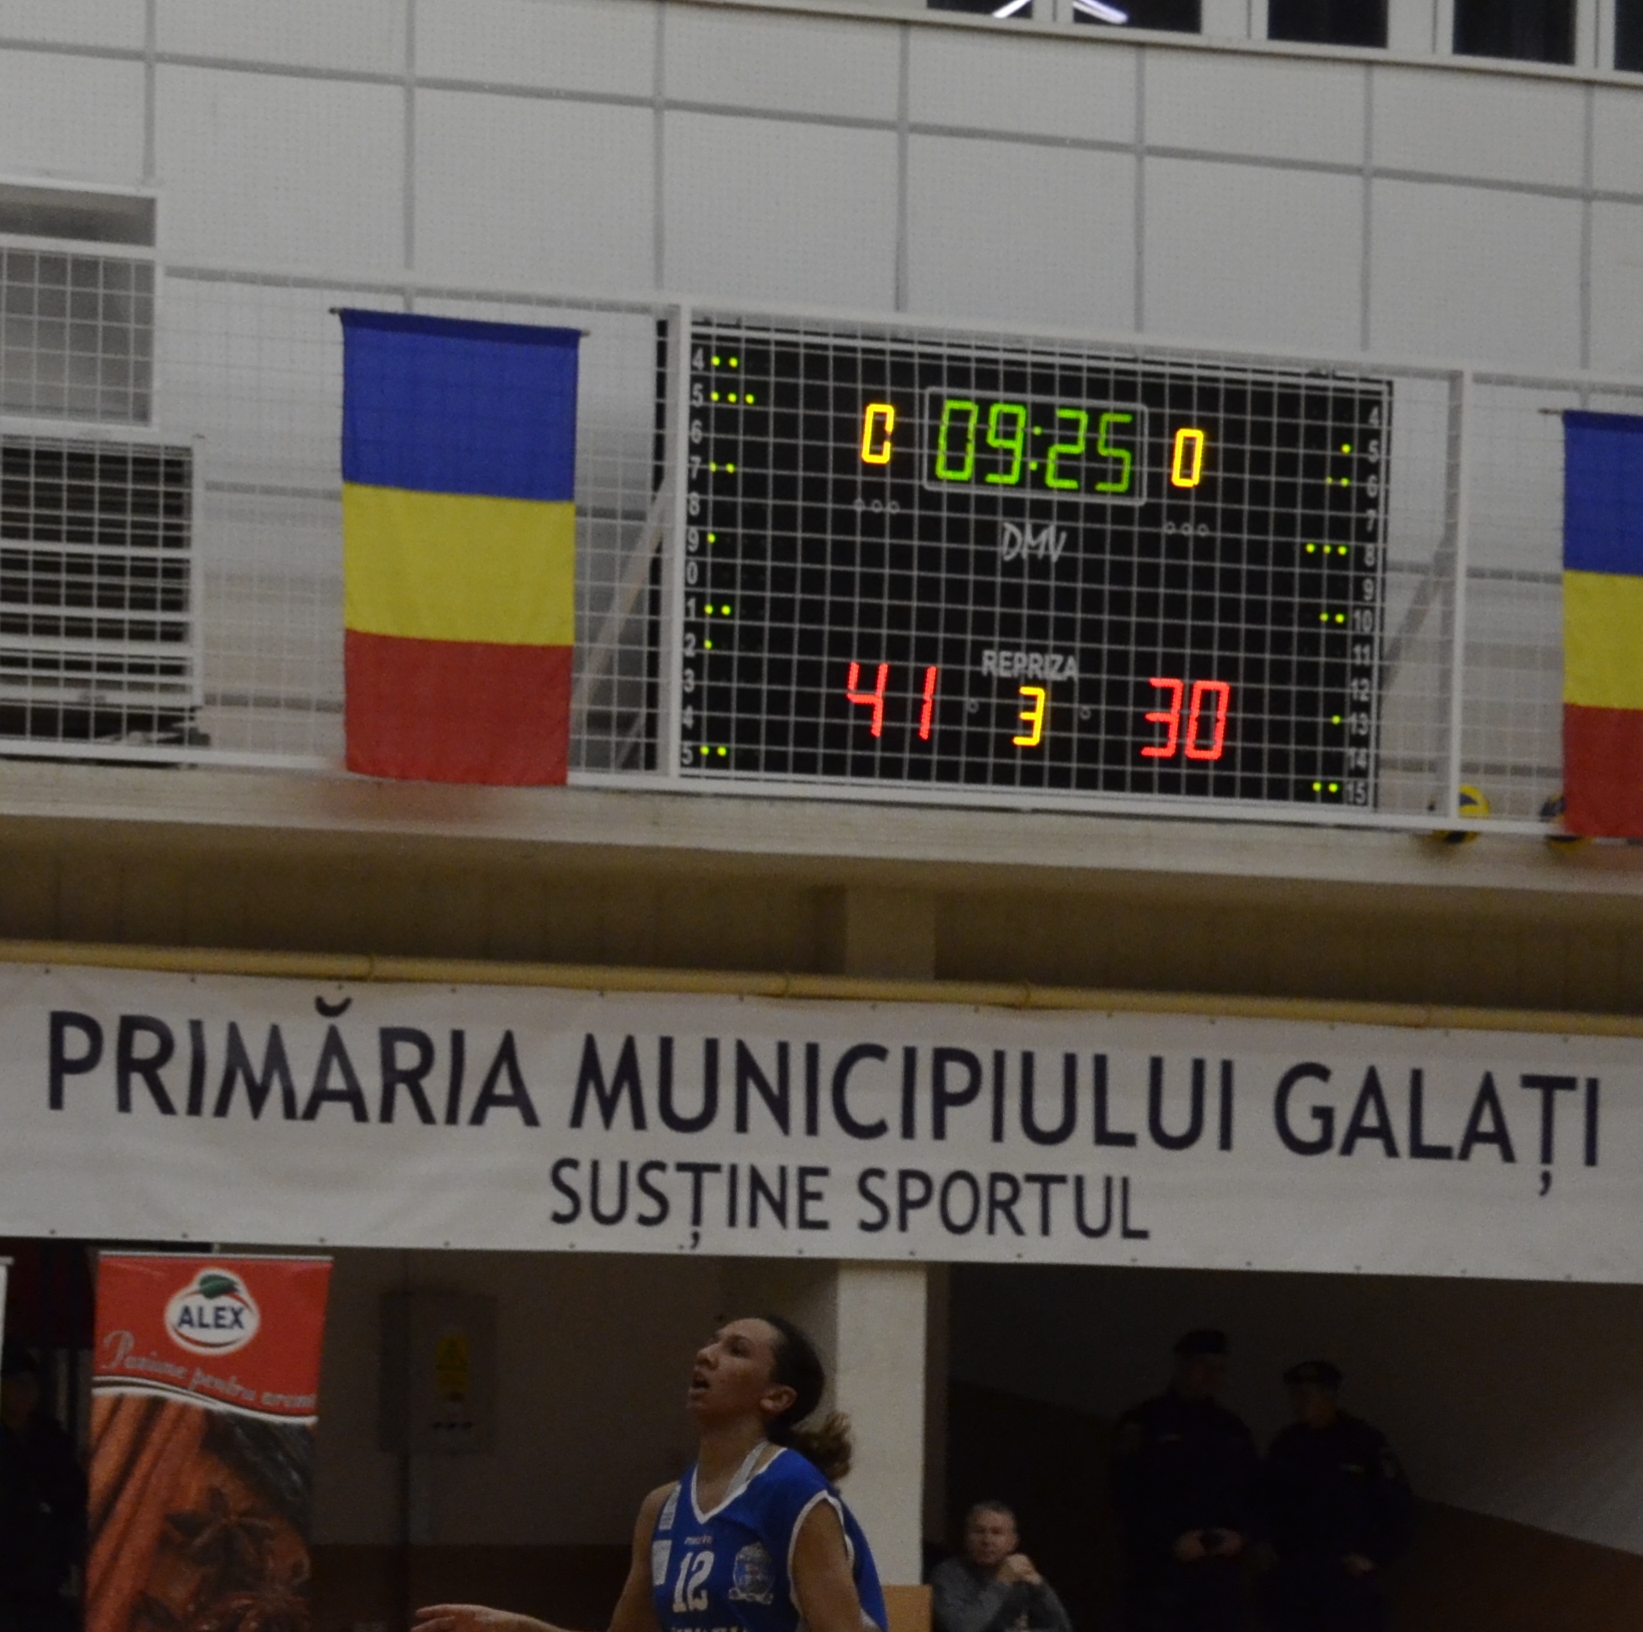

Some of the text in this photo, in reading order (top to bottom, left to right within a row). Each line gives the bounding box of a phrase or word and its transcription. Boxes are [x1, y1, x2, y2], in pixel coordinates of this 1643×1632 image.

[935, 399, 1134, 494] 09:25
[1171, 427, 1205, 489] 0
[1002, 521, 1067, 563] DMV
[1353, 608, 1373, 633] 10
[981, 649, 1079, 682] REPRIZA
[1353, 643, 1371, 667] 11
[1350, 677, 1371, 702] 12
[846, 661, 1233, 762] 41 3 30
[1349, 712, 1369, 736] 13
[48, 995, 1599, 1197] PRIMĂRIA MUNICIPIULUI GALAȚI
[550, 1157, 1150, 1248] SUSȚINE SPORTUL
[177, 1305, 245, 1329] ALEX
[672, 1550, 715, 1613] 12
